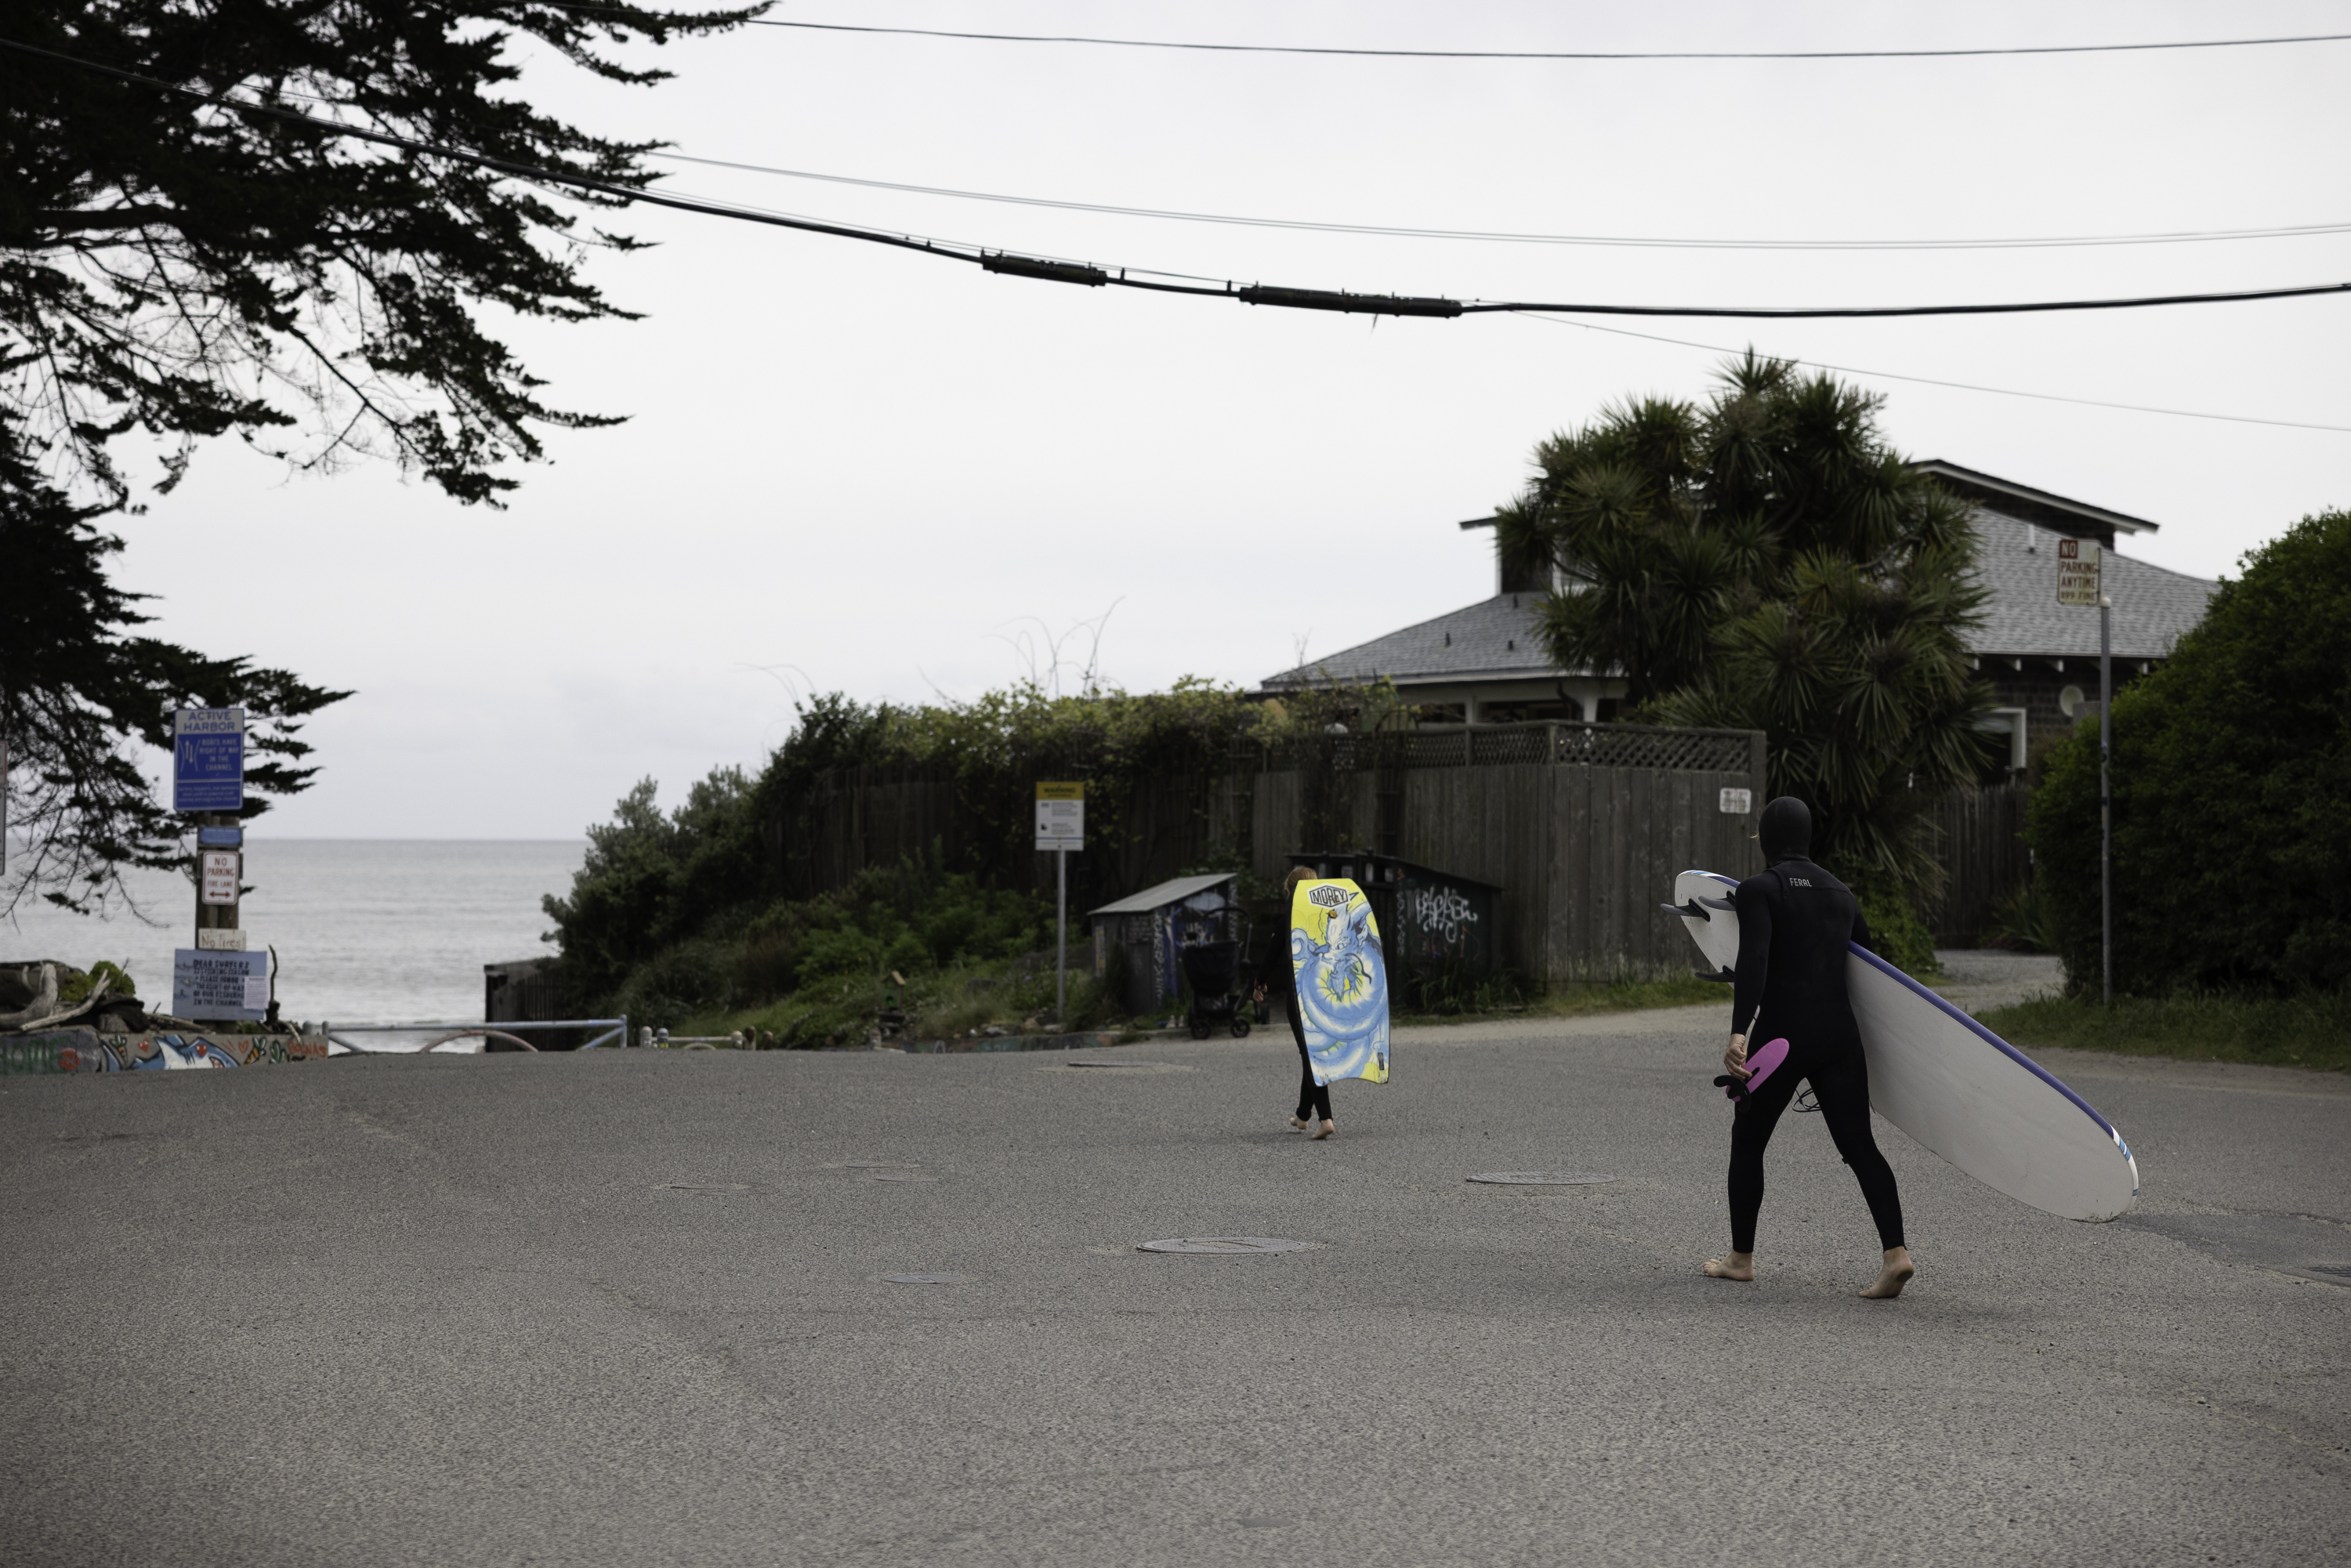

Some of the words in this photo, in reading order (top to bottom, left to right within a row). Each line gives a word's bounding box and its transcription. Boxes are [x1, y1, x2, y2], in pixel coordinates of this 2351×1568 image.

[2062, 541, 2077, 557] NO
[2061, 561, 2098, 574] PARKING
[2061, 576, 2096, 589] ANYTIME
[189, 712, 232, 721] ACTIVE
[183, 722, 235, 731] HARBOR
[199, 746, 217, 755] RIGHT
[205, 763, 233, 772] CHANNEL
[215, 856, 227, 867] NO
[207, 867, 234, 877] PARKING
[1789, 878, 1813, 887] FERAL
[1313, 888, 1345, 905] MOREY
[201, 934, 216, 949] No
[193, 959, 213, 968] DEAR
[215, 960, 250, 969] SURFERS
